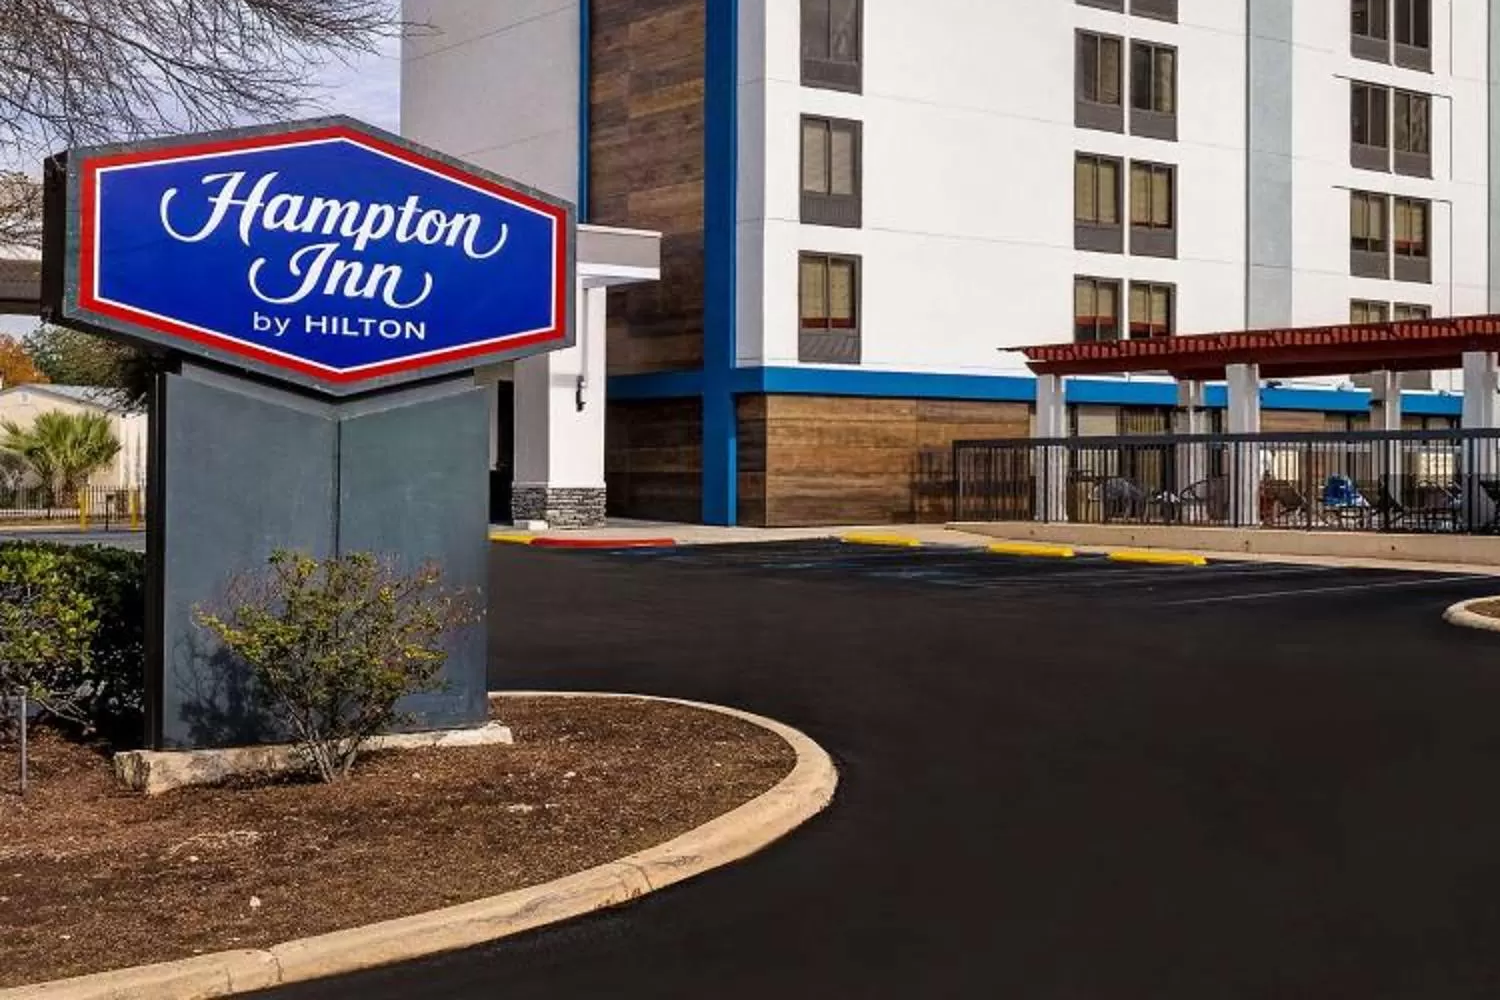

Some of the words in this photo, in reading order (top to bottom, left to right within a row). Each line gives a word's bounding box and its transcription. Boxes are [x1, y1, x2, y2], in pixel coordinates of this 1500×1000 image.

[159, 171, 509, 259] Hampton
[248, 242, 433, 309] Inn
[253, 311, 291, 337] by
[305, 315, 425, 340] HILTON
